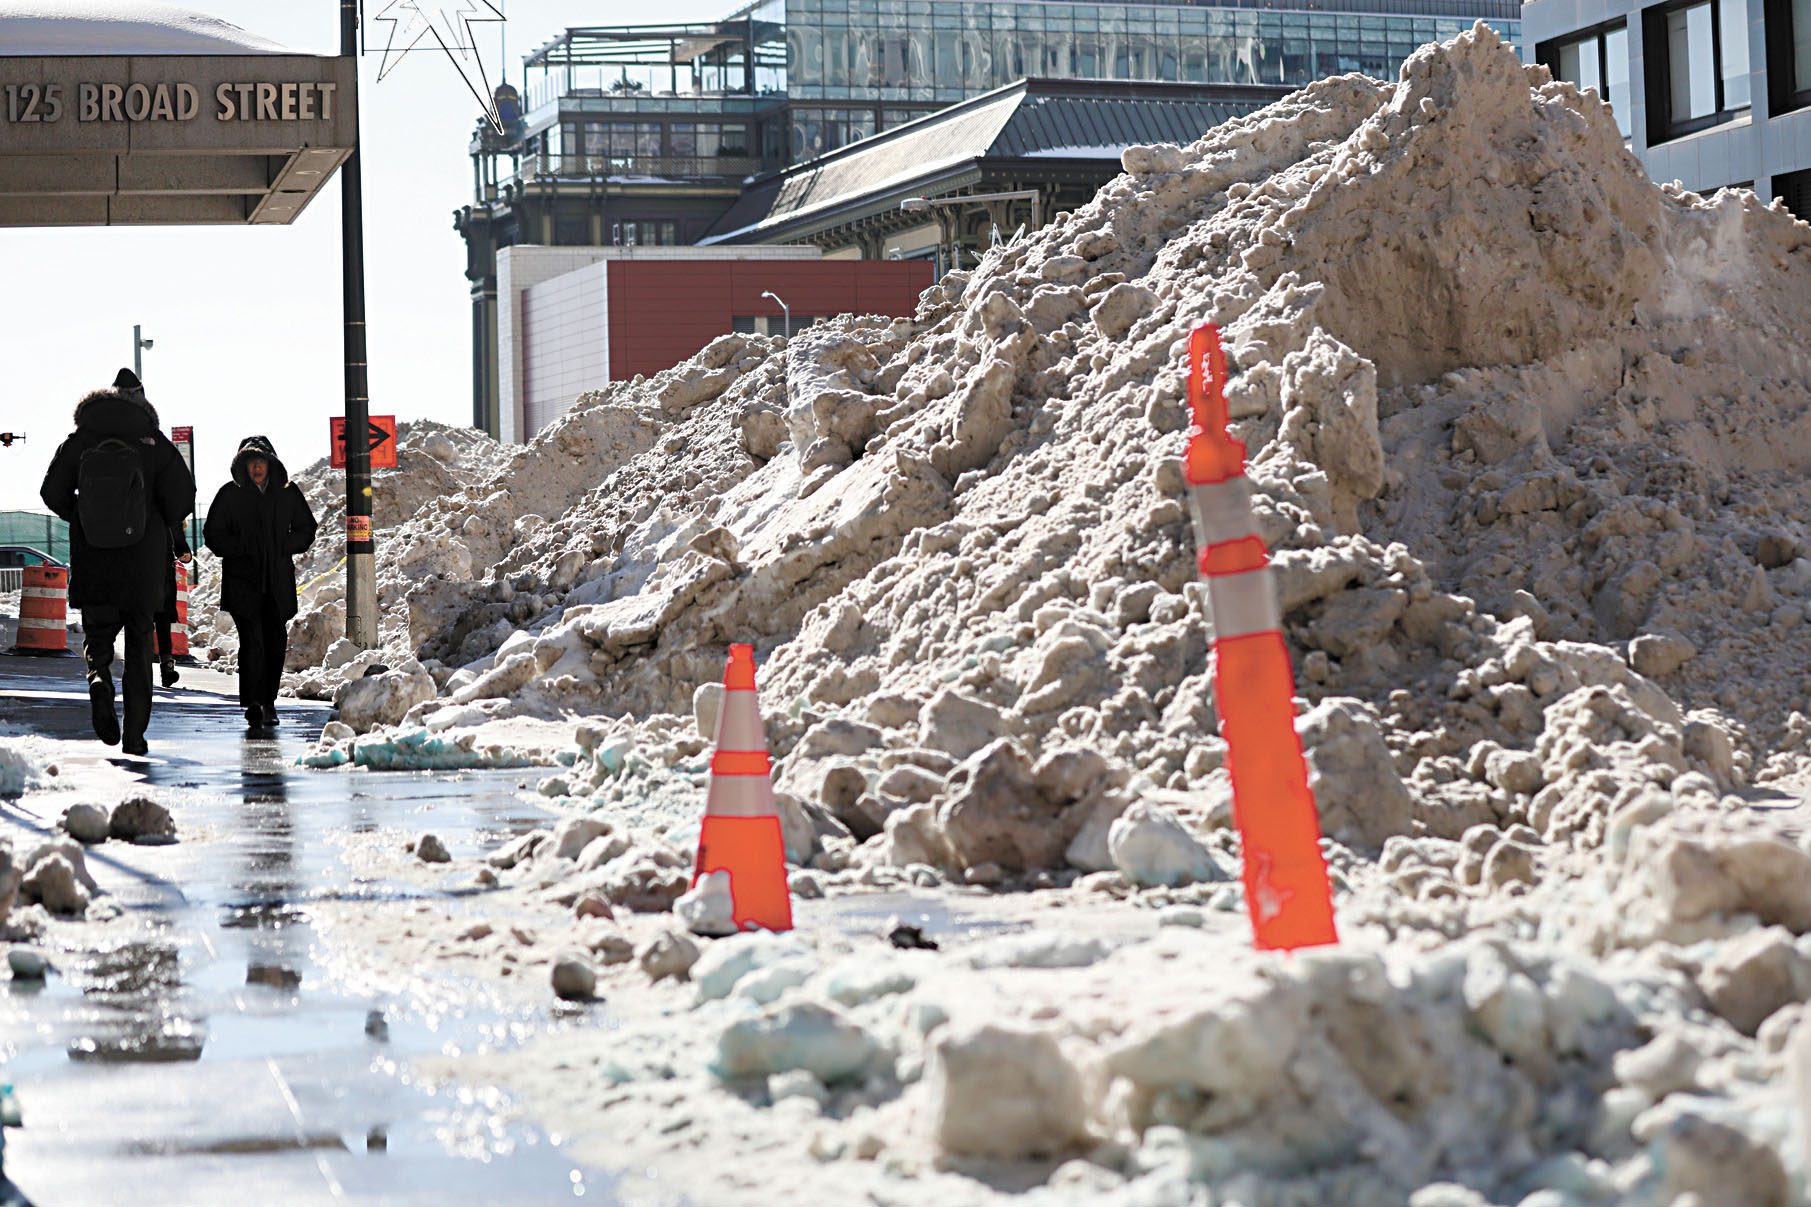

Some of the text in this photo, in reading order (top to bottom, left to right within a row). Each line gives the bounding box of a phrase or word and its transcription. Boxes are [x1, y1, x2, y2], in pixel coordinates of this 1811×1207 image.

[6, 82, 336, 122] 125 BROAD STREET
